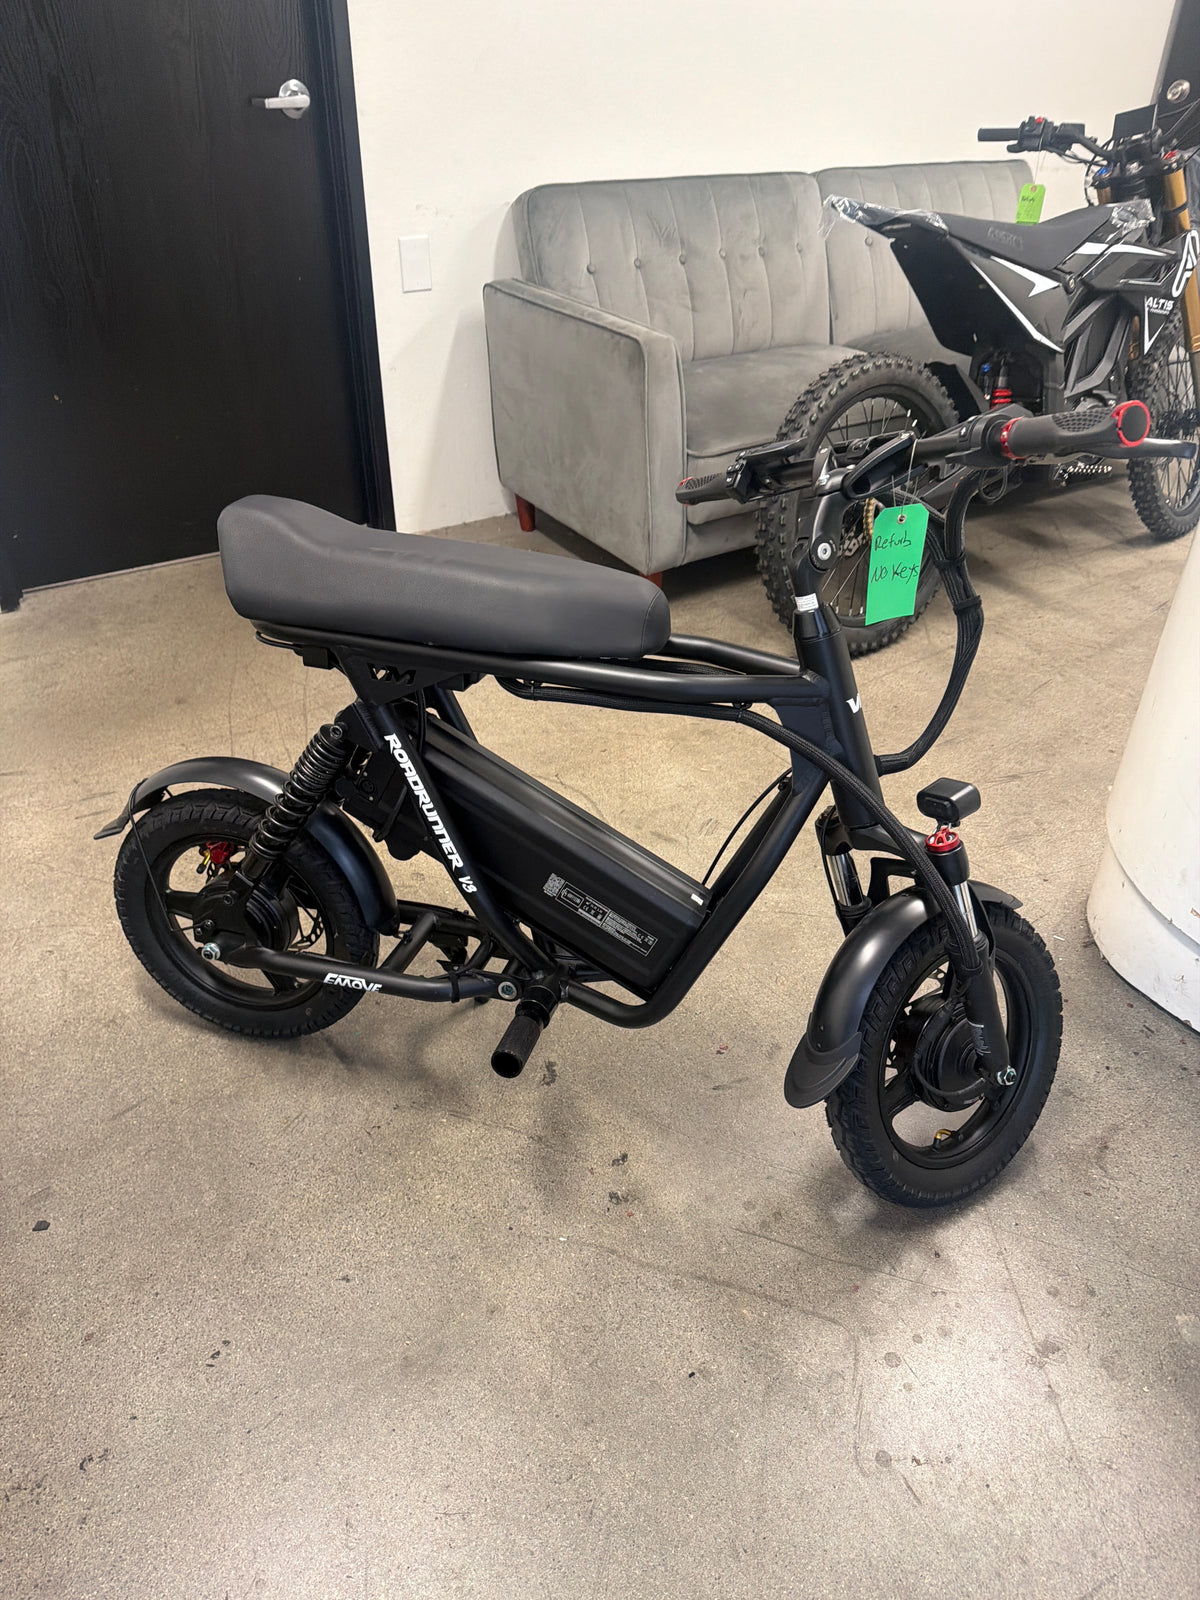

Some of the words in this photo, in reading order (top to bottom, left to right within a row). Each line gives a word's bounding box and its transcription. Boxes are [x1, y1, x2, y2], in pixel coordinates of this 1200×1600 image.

[1146, 296, 1175, 311] ALTIS
[874, 530, 912, 551] Refurb
[384, 733, 464, 872] ROADRUNNER
[459, 875, 478, 894] V3
[323, 972, 383, 993] EMOVE
